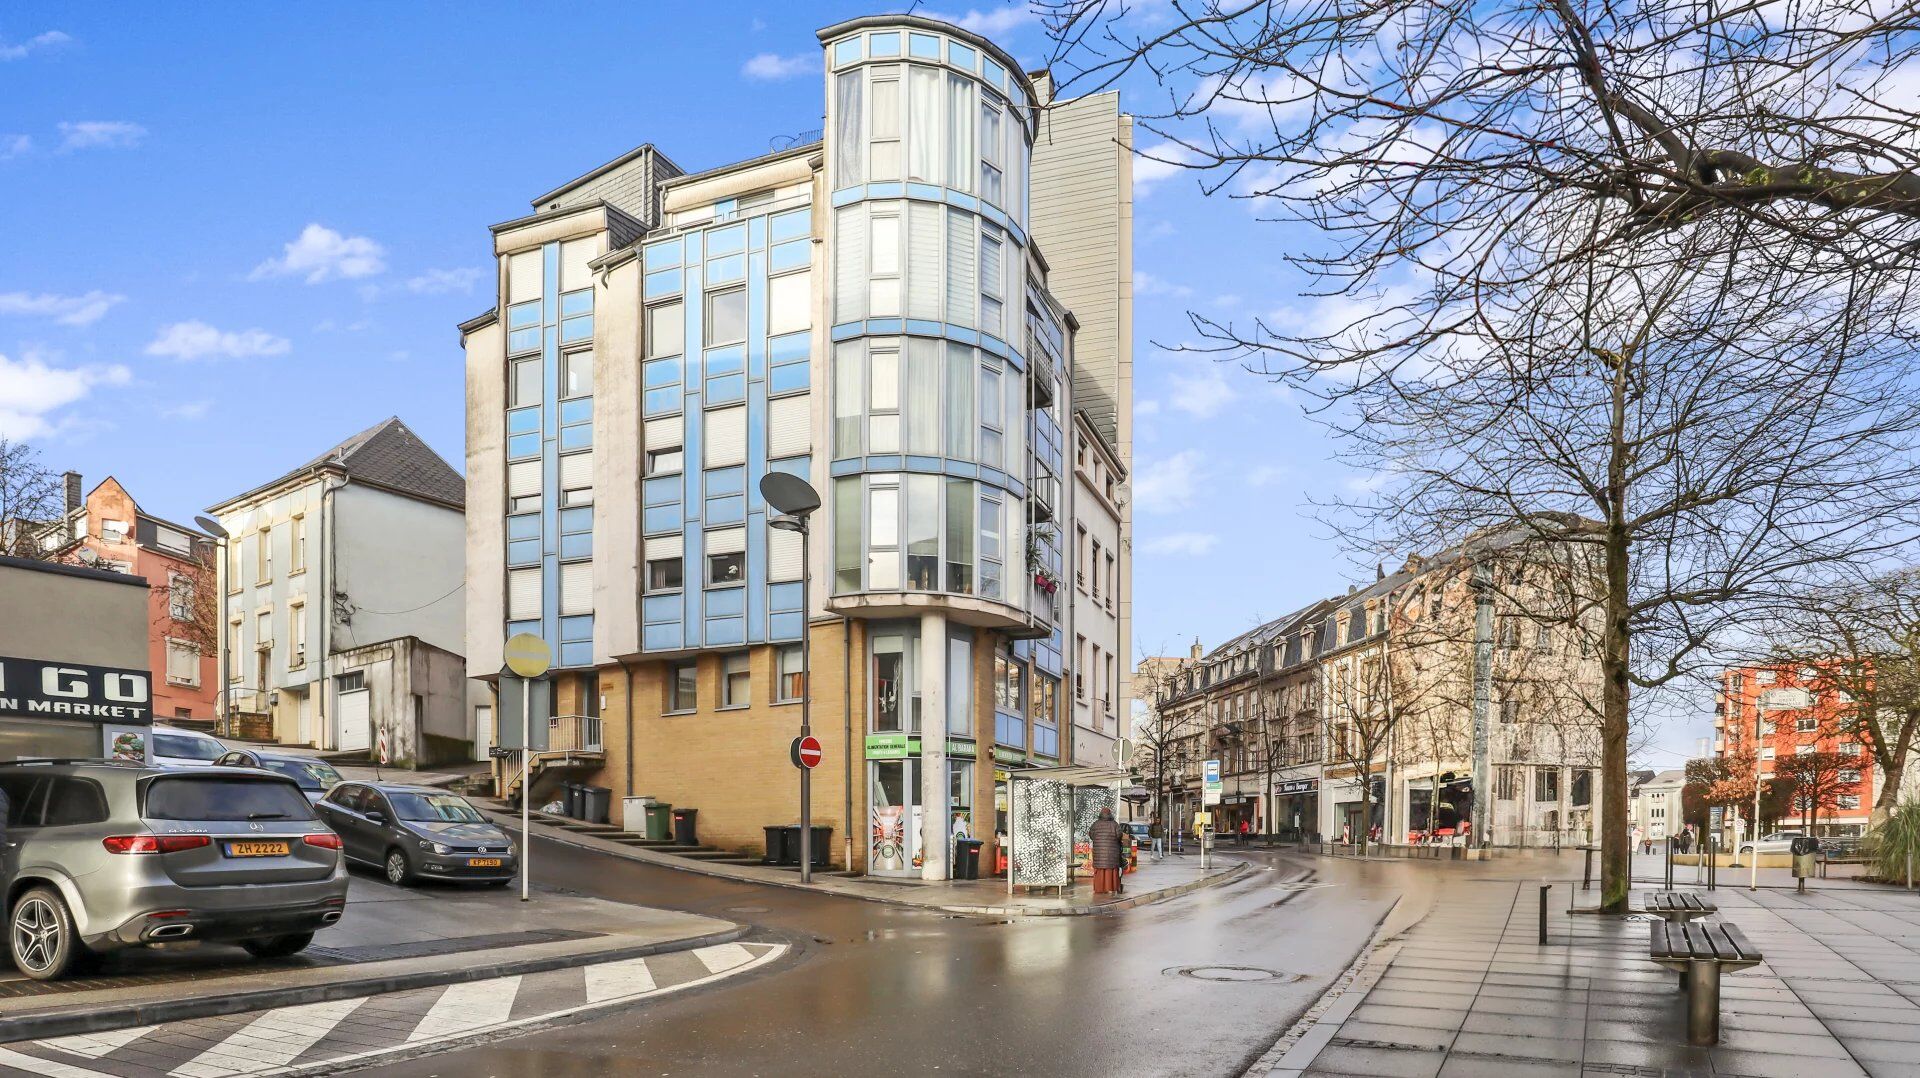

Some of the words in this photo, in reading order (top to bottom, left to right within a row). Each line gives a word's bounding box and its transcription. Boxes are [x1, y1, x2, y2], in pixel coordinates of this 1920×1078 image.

[0, 662, 148, 703] GO
[27, 699, 147, 719] MARKET
[236, 843, 252, 854] ZH
[255, 843, 284, 854] 2222
